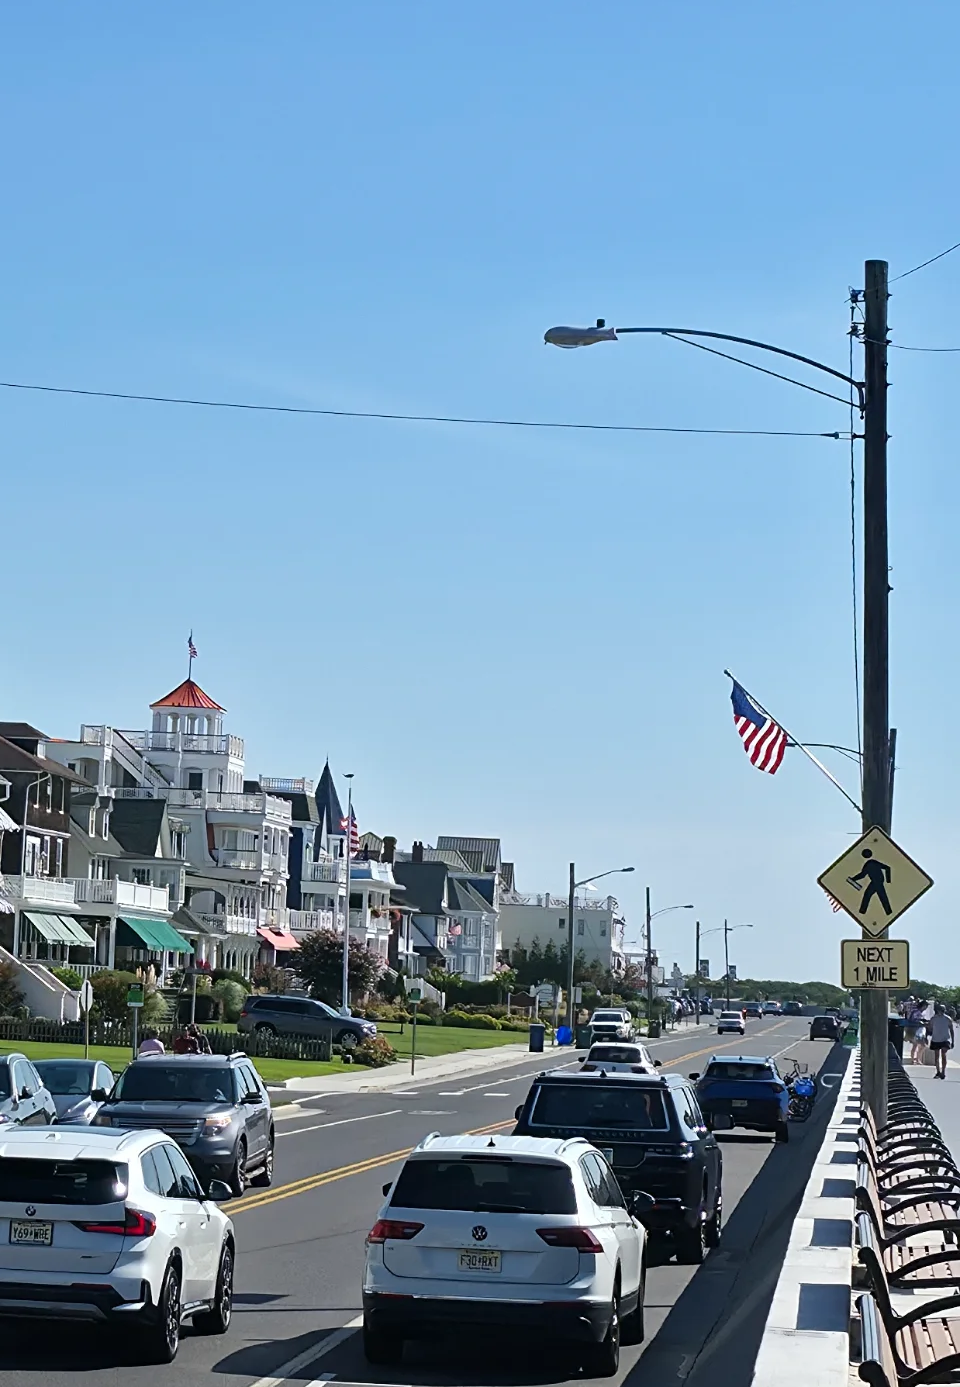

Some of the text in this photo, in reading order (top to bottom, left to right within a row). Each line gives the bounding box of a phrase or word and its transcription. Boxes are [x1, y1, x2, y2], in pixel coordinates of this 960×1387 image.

[857, 947, 894, 962] NEXT
[853, 966, 898, 982] 1 MILE
